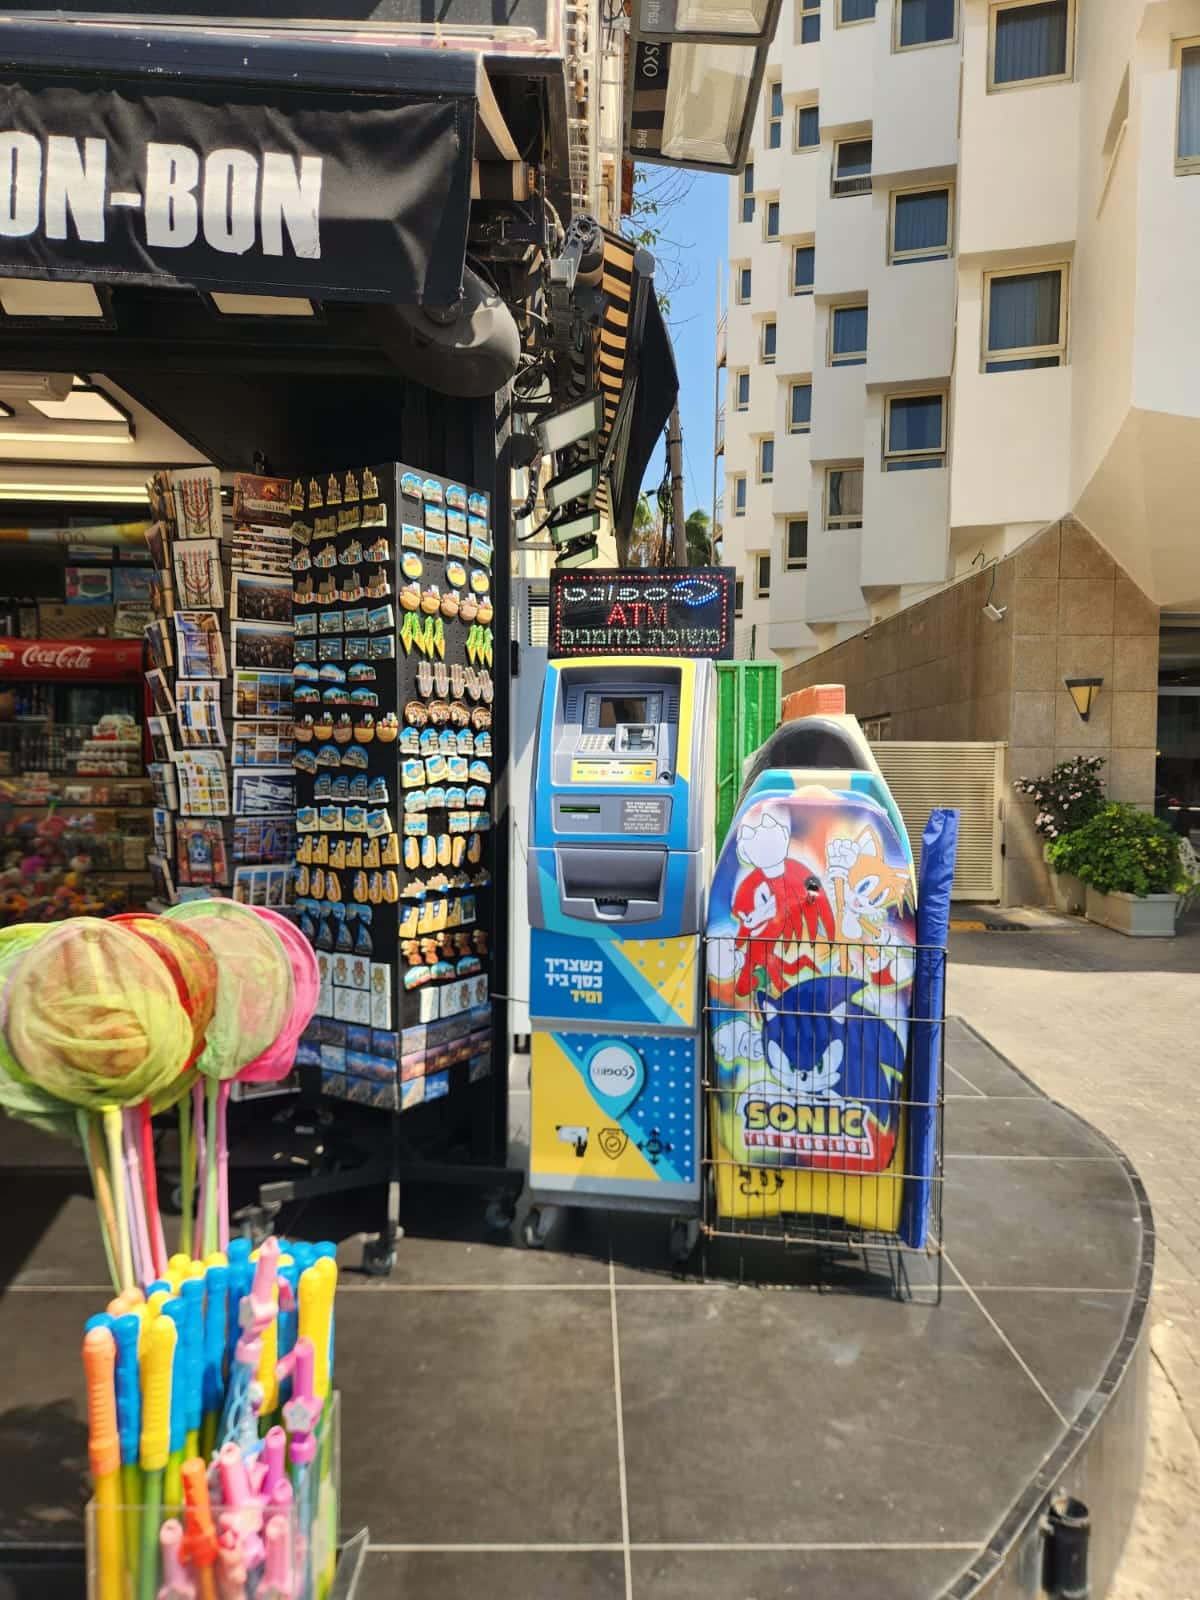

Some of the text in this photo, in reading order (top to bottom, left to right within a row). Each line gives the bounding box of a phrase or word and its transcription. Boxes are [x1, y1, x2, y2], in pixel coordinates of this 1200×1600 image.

[0, 131, 323, 259] ON-BON
[607, 602, 669, 626] ATM
[560, 628, 721, 646] משיכת מזומנים
[544, 957, 604, 973] כשצריך
[544, 973, 603, 989] כסף ביד
[570, 989, 603, 1004] ומיד
[745, 1100, 867, 1138] SONIC
